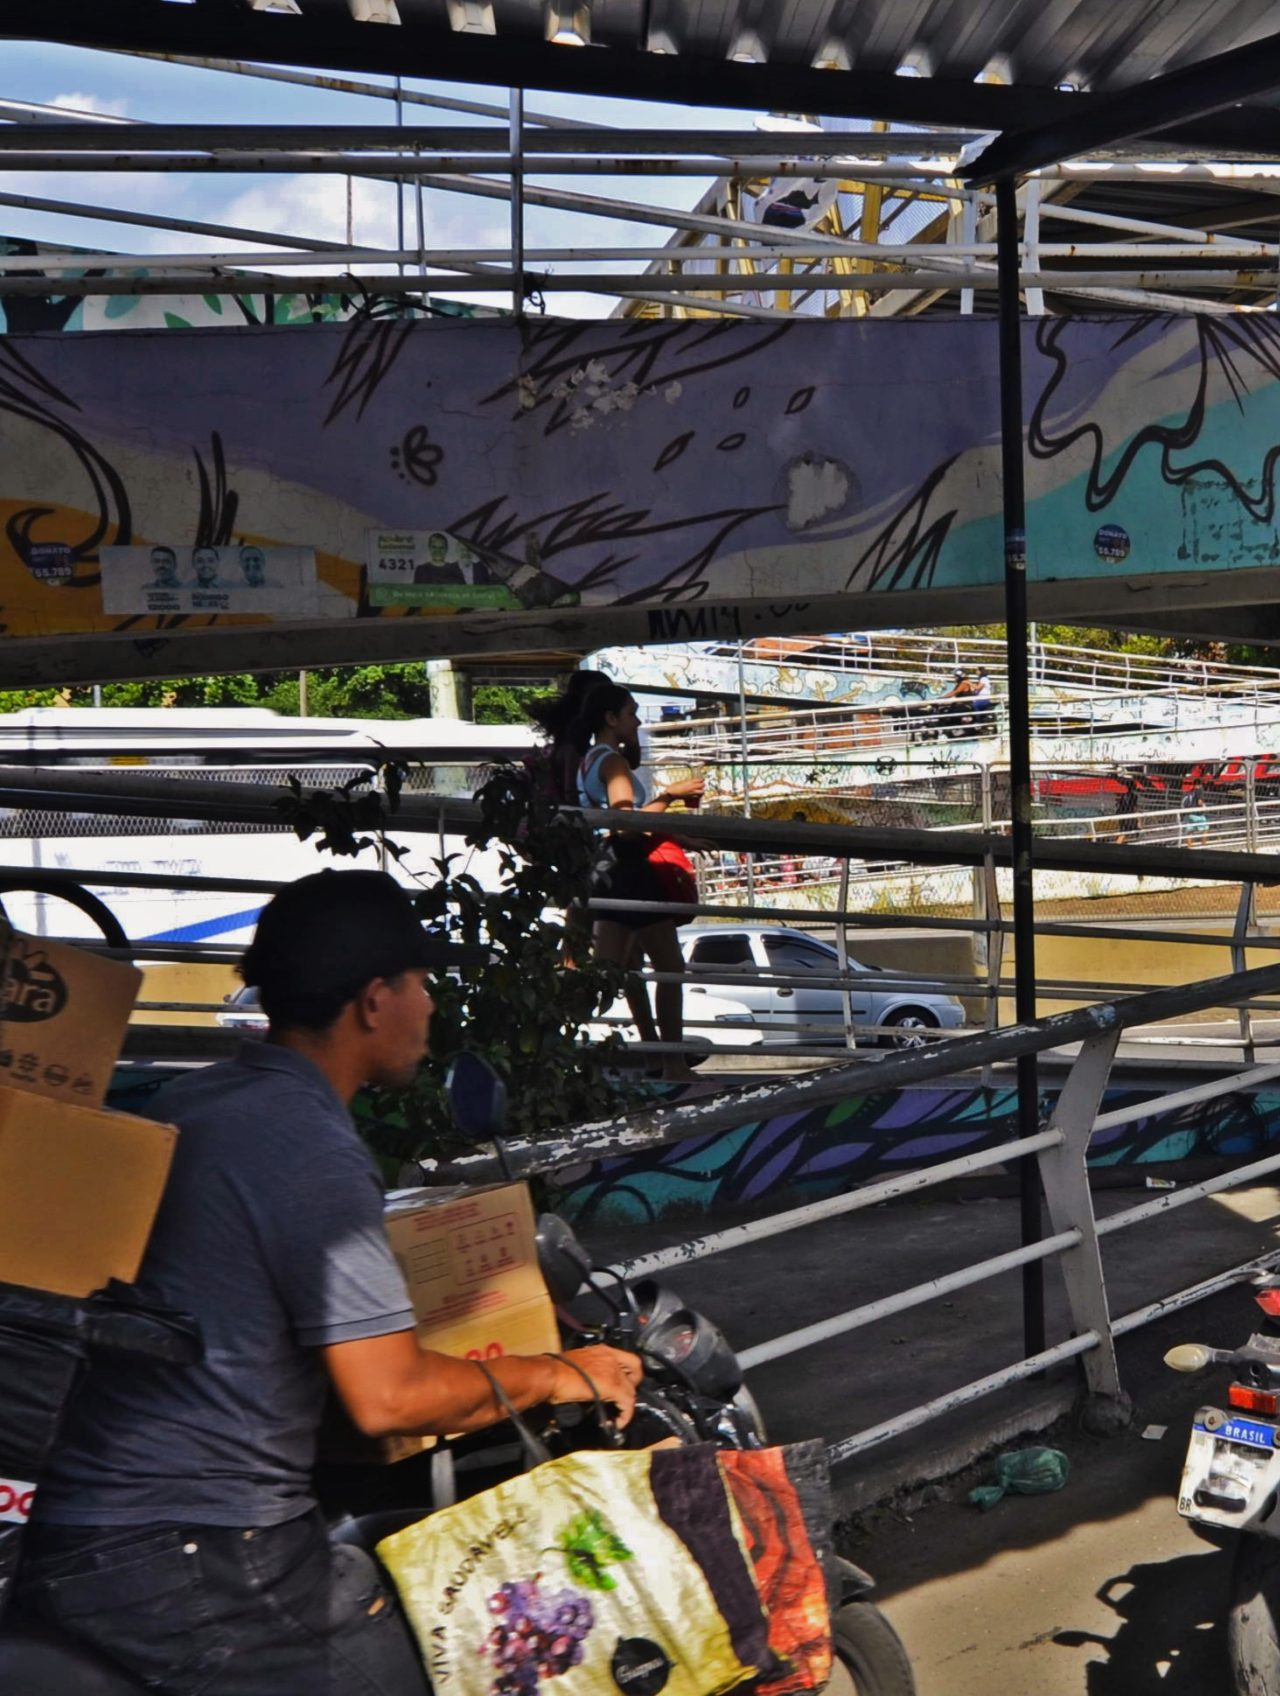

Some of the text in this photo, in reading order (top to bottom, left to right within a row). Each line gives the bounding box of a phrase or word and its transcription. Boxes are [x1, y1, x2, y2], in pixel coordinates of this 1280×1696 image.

[378, 558, 415, 571] 4321
[1224, 1425, 1266, 1444] BRASIL
[1179, 1495, 1192, 1512] BR
[430, 1625, 450, 1684] VIVA
